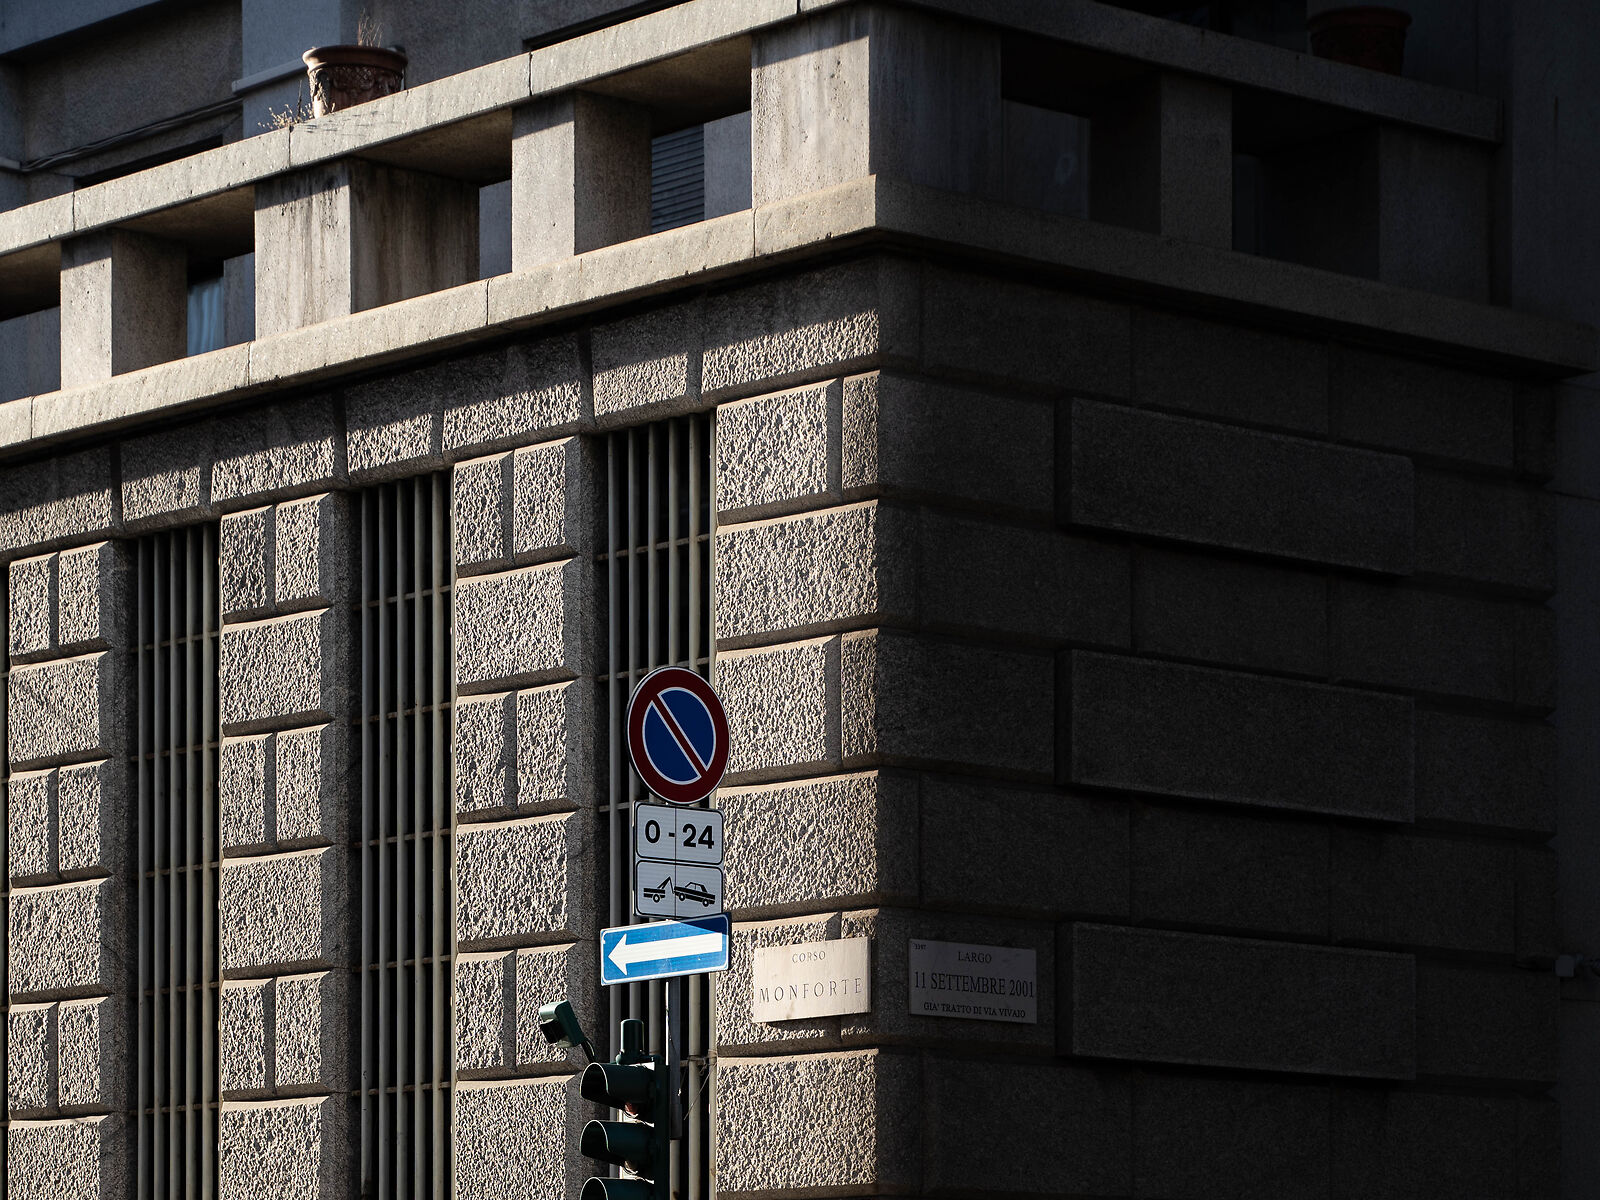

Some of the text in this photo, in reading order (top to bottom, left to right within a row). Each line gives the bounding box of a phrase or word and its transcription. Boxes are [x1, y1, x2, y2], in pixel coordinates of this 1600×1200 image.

[792, 950, 826, 963] CORSO
[957, 951, 992, 964] LARGO
[760, 978, 862, 1003] MONFORTE
[914, 971, 1034, 998] 11 SETTEMBRE 2001
[942, 1003, 972, 1015] TRATTO
[973, 1005, 982, 1015] DI
[983, 1007, 997, 1016] VIA
[999, 1008, 1026, 1018] VIVAIO
